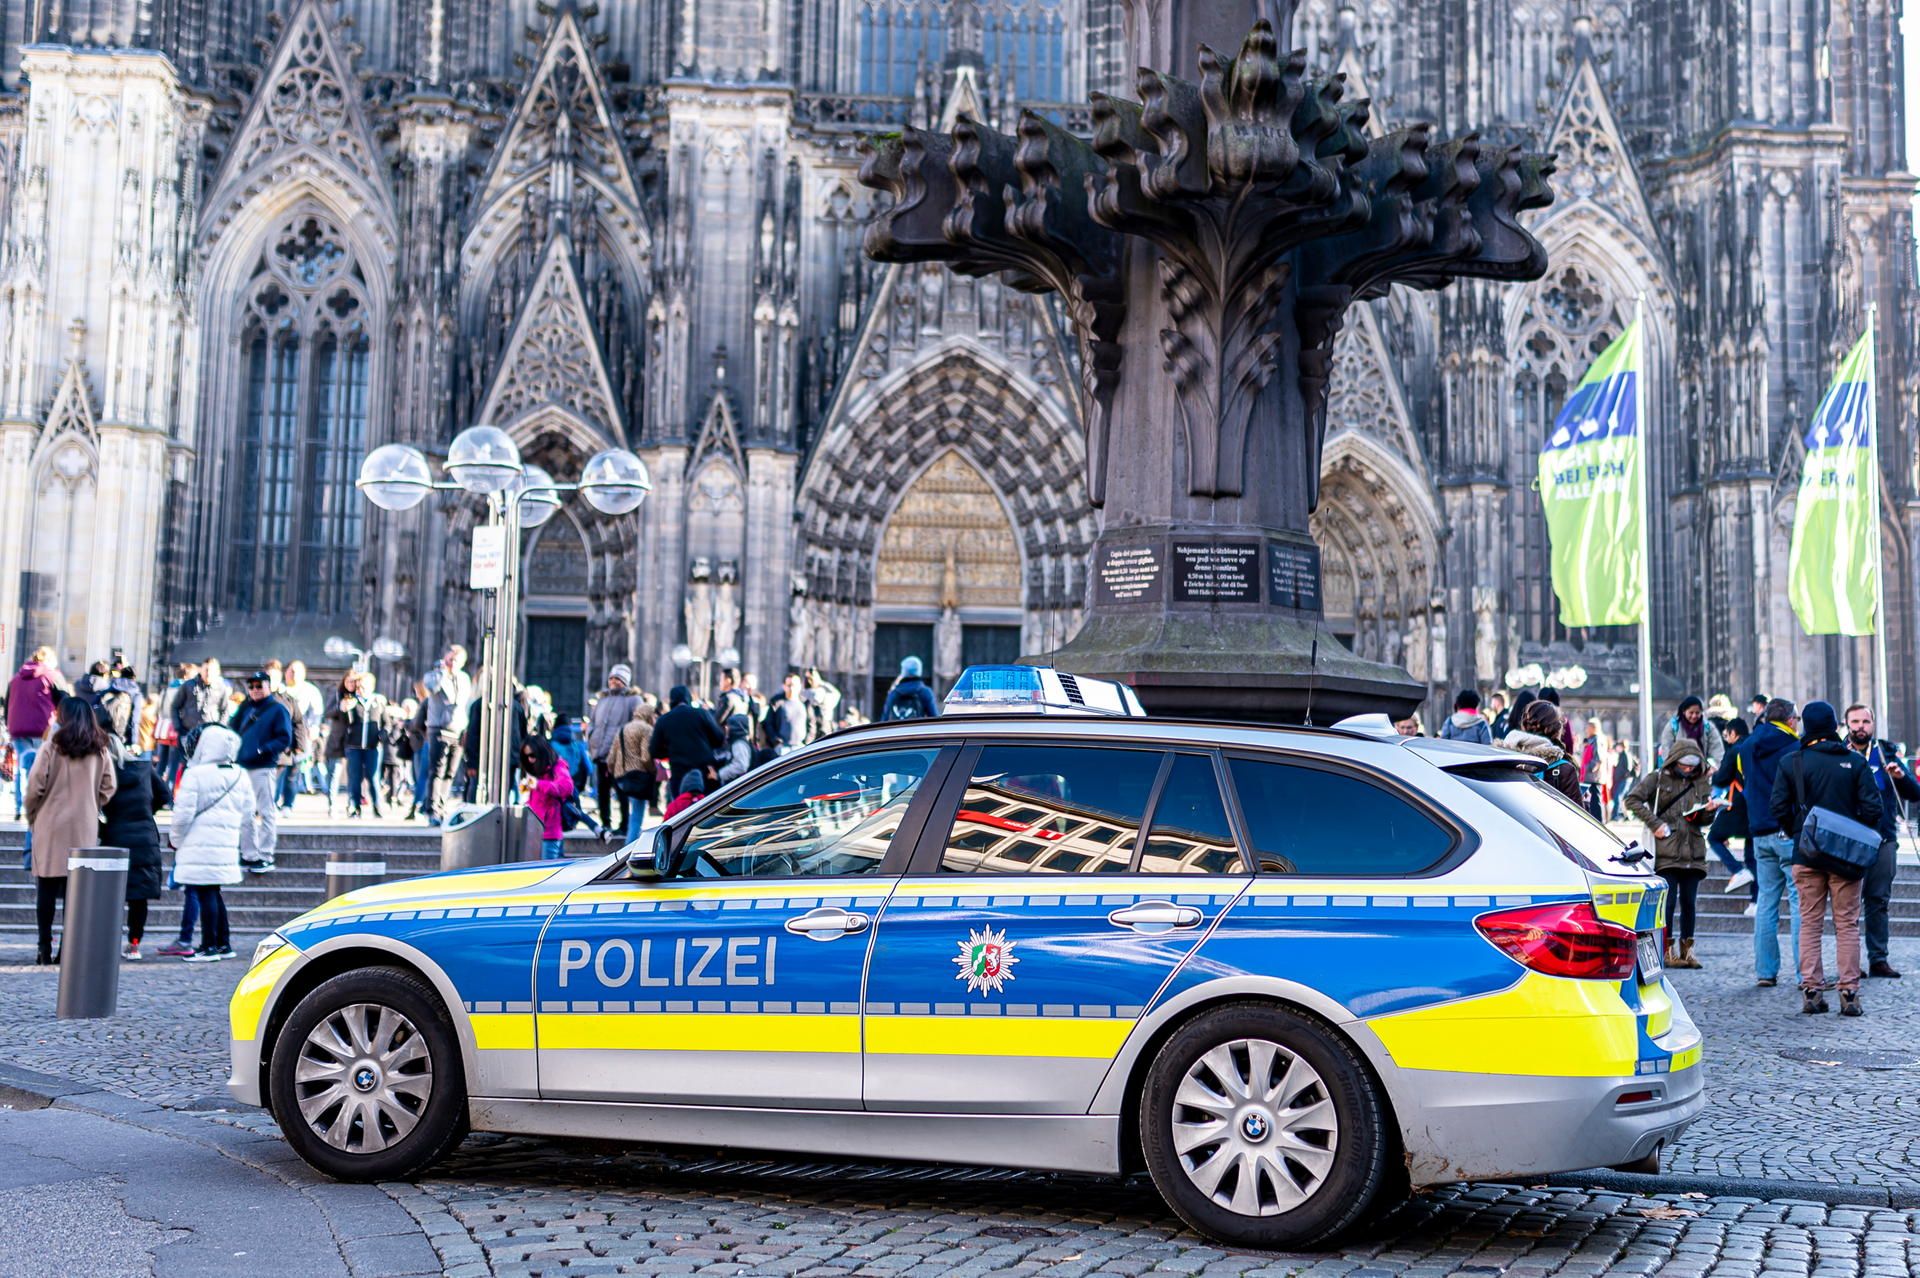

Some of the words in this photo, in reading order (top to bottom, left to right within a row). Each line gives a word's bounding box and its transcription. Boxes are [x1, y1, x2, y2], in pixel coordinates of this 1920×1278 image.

[1555, 469, 1580, 485] BEI
[558, 936, 777, 988] POLIZEI
[1337, 1072, 1364, 1170] BRIDGESTONE
